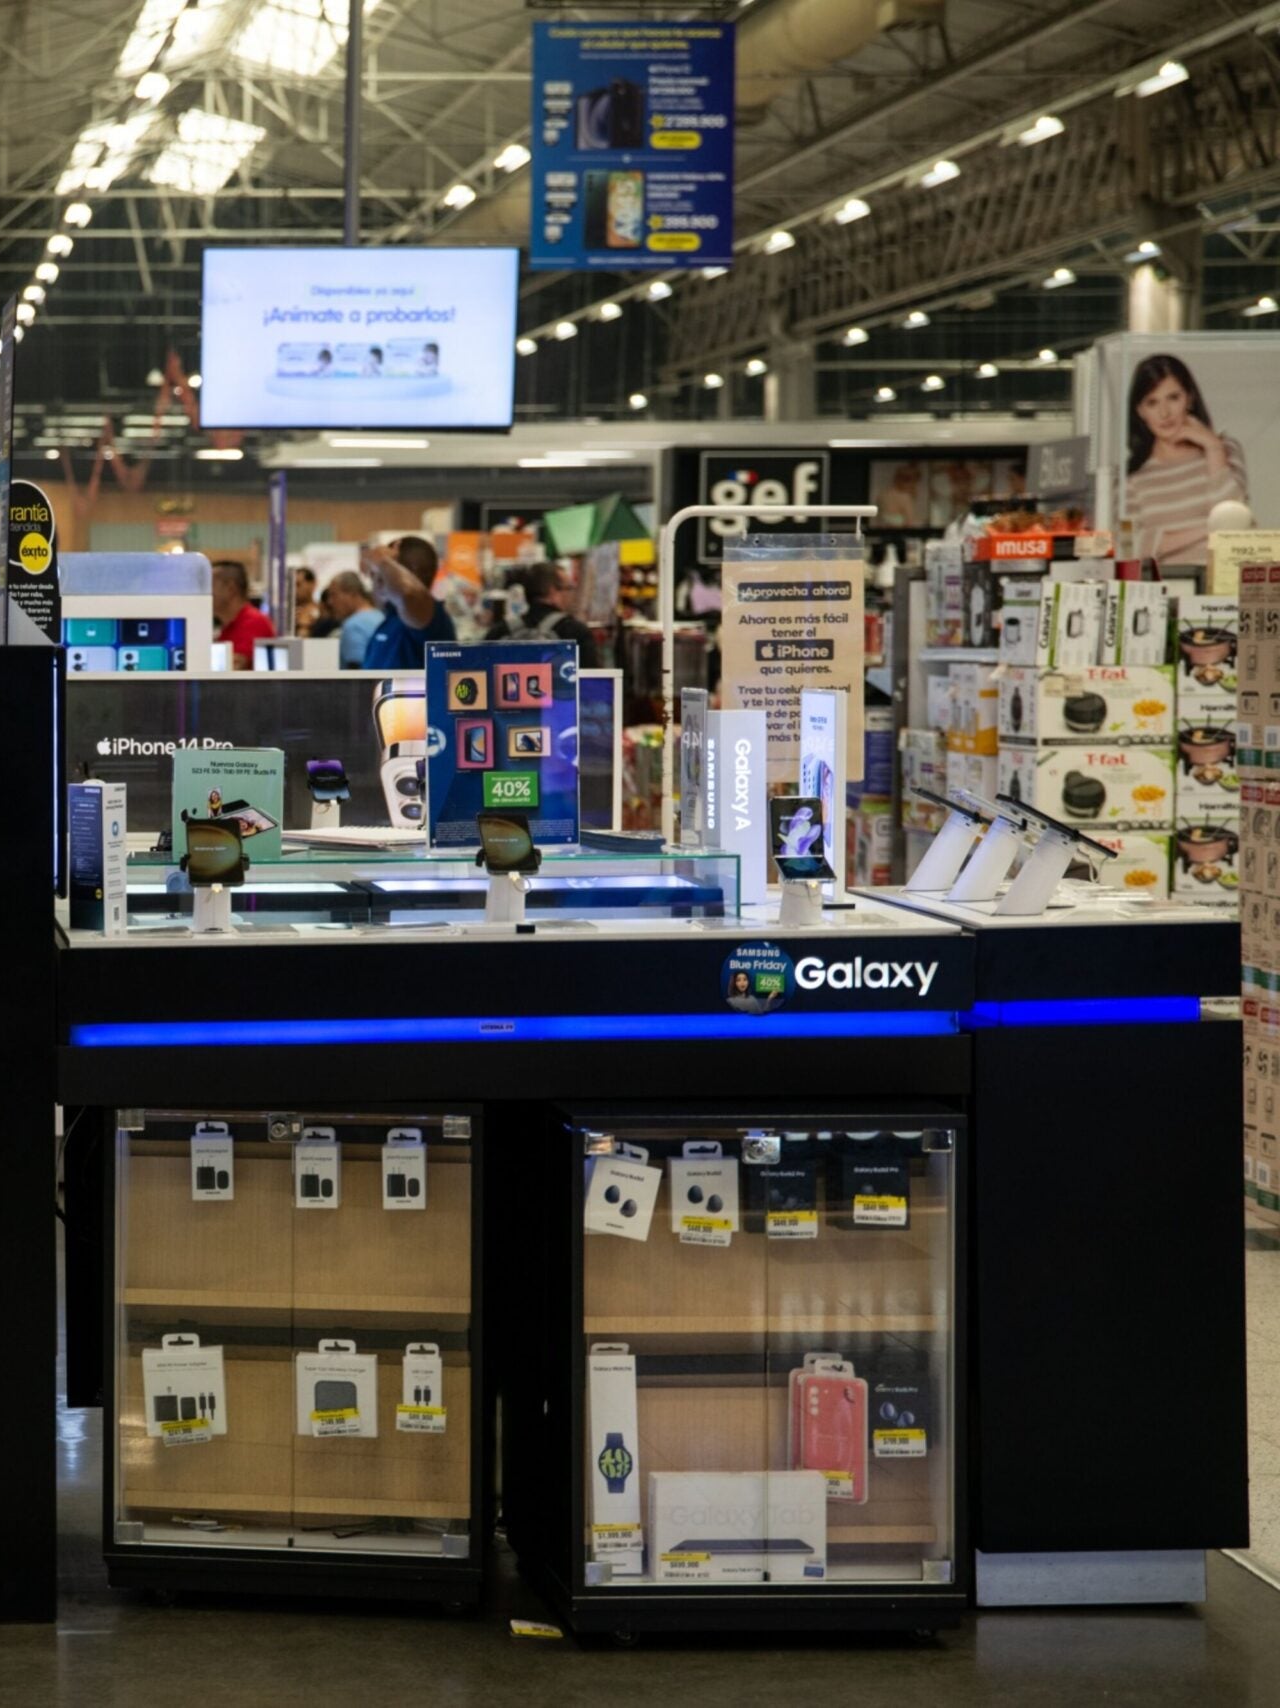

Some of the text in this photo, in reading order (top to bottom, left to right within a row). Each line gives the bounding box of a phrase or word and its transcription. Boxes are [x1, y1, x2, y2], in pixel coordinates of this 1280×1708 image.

[710, 462, 819, 537] gef
[812, 585, 850, 597] ahora!
[739, 613, 849, 625] Ahora es más fácil
[772, 628, 817, 638] tener el
[777, 644, 830, 659] iPhone
[760, 663, 832, 677] que quieres.
[738, 685, 763, 695] Trae
[765, 685, 777, 695] tu
[112, 737, 176, 756] iPhone
[178, 737, 199, 749] 14
[492, 781, 531, 797] 40%
[707, 738, 716, 829] SAMSUNG
[730, 738, 753, 831] Galaxy A
[736, 948, 780, 957] SAMSUNG
[729, 960, 787, 972] Blue Friday
[759, 978, 781, 987] 40%
[794, 956, 939, 996] Galaxy
